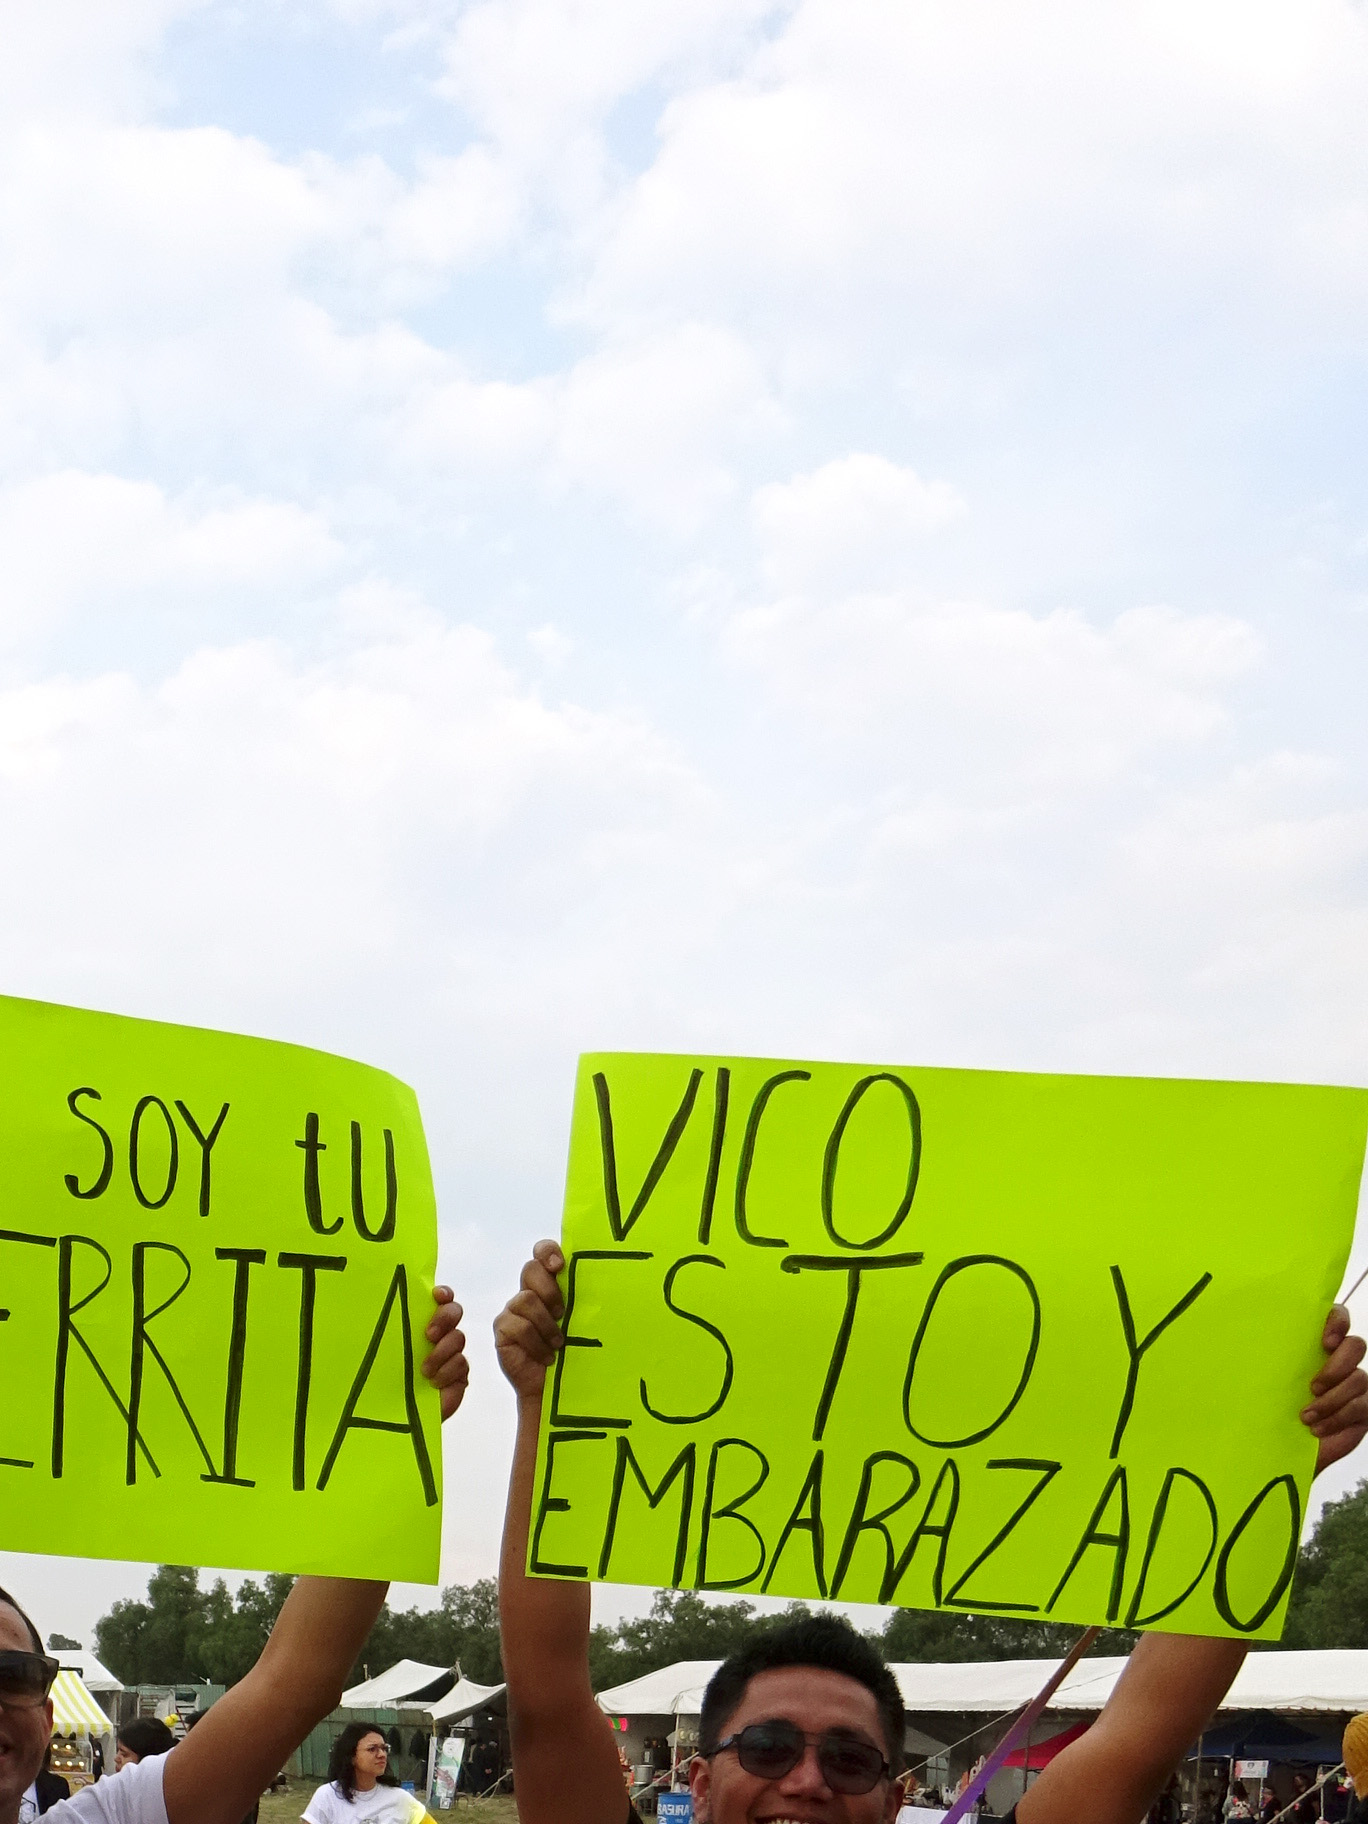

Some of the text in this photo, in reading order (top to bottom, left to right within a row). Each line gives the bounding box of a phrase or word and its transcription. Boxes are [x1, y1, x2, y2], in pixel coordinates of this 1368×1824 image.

[64, 1087, 230, 1217] SOY
[592, 1067, 923, 1251] VICO
[549, 1250, 1213, 1460] ESTOY
[530, 1430, 1301, 1633] EMBARAZADO
